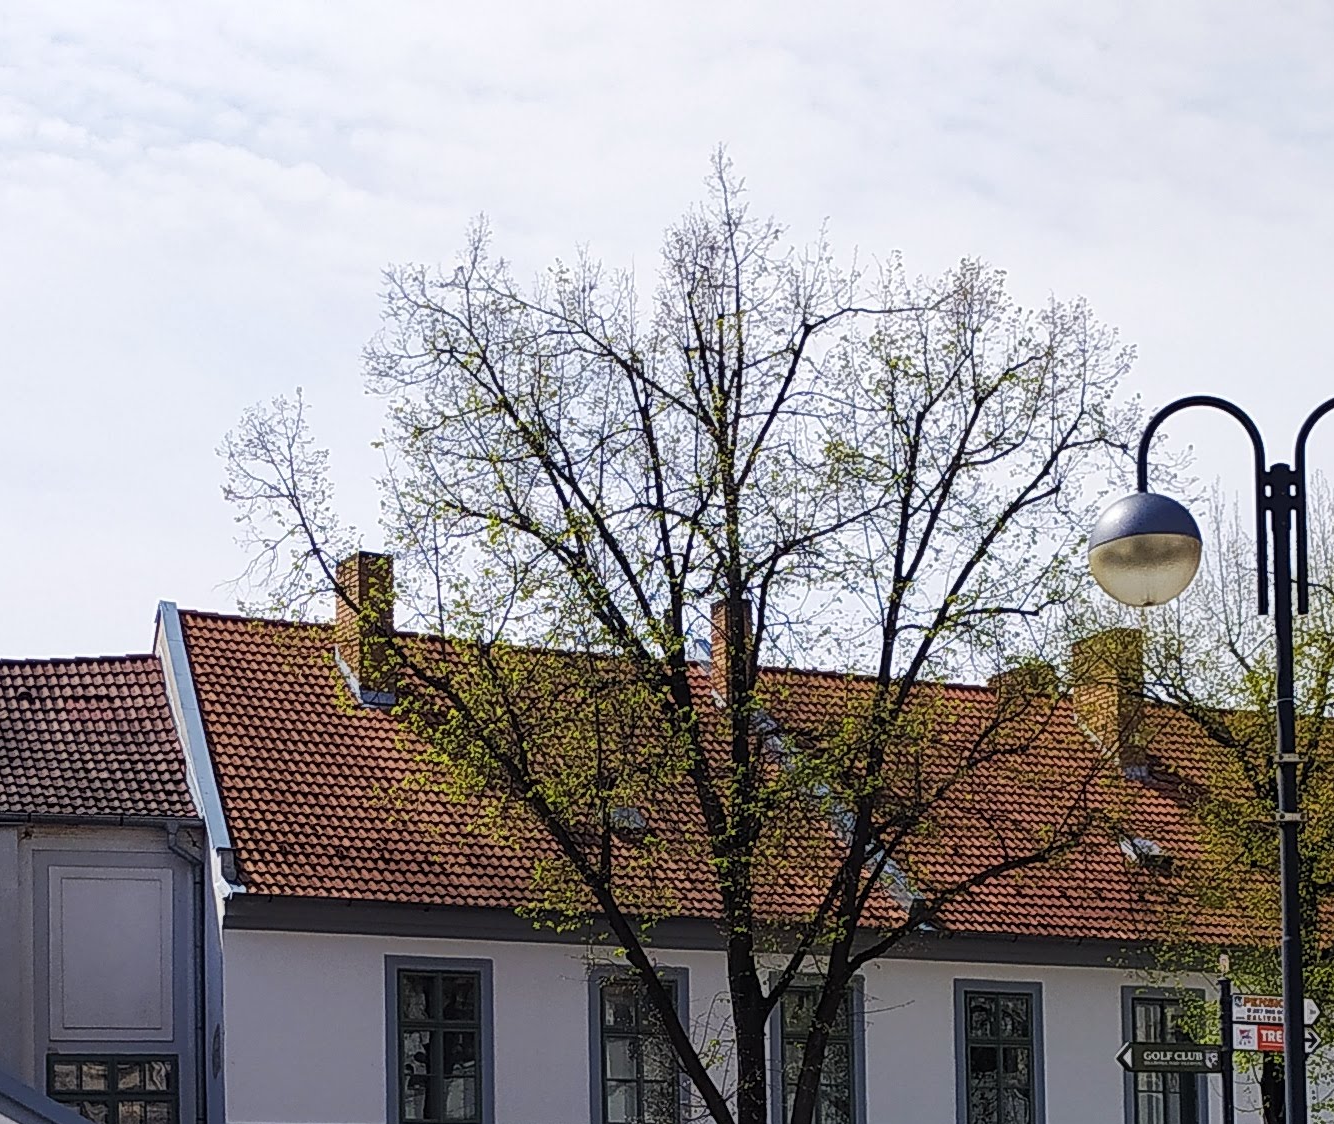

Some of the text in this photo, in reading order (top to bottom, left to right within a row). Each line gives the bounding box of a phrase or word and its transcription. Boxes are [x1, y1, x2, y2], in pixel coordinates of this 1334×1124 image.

[1260, 1030, 1283, 1043] TRE
[1143, 1051, 1204, 1061] GOLF CLUB
